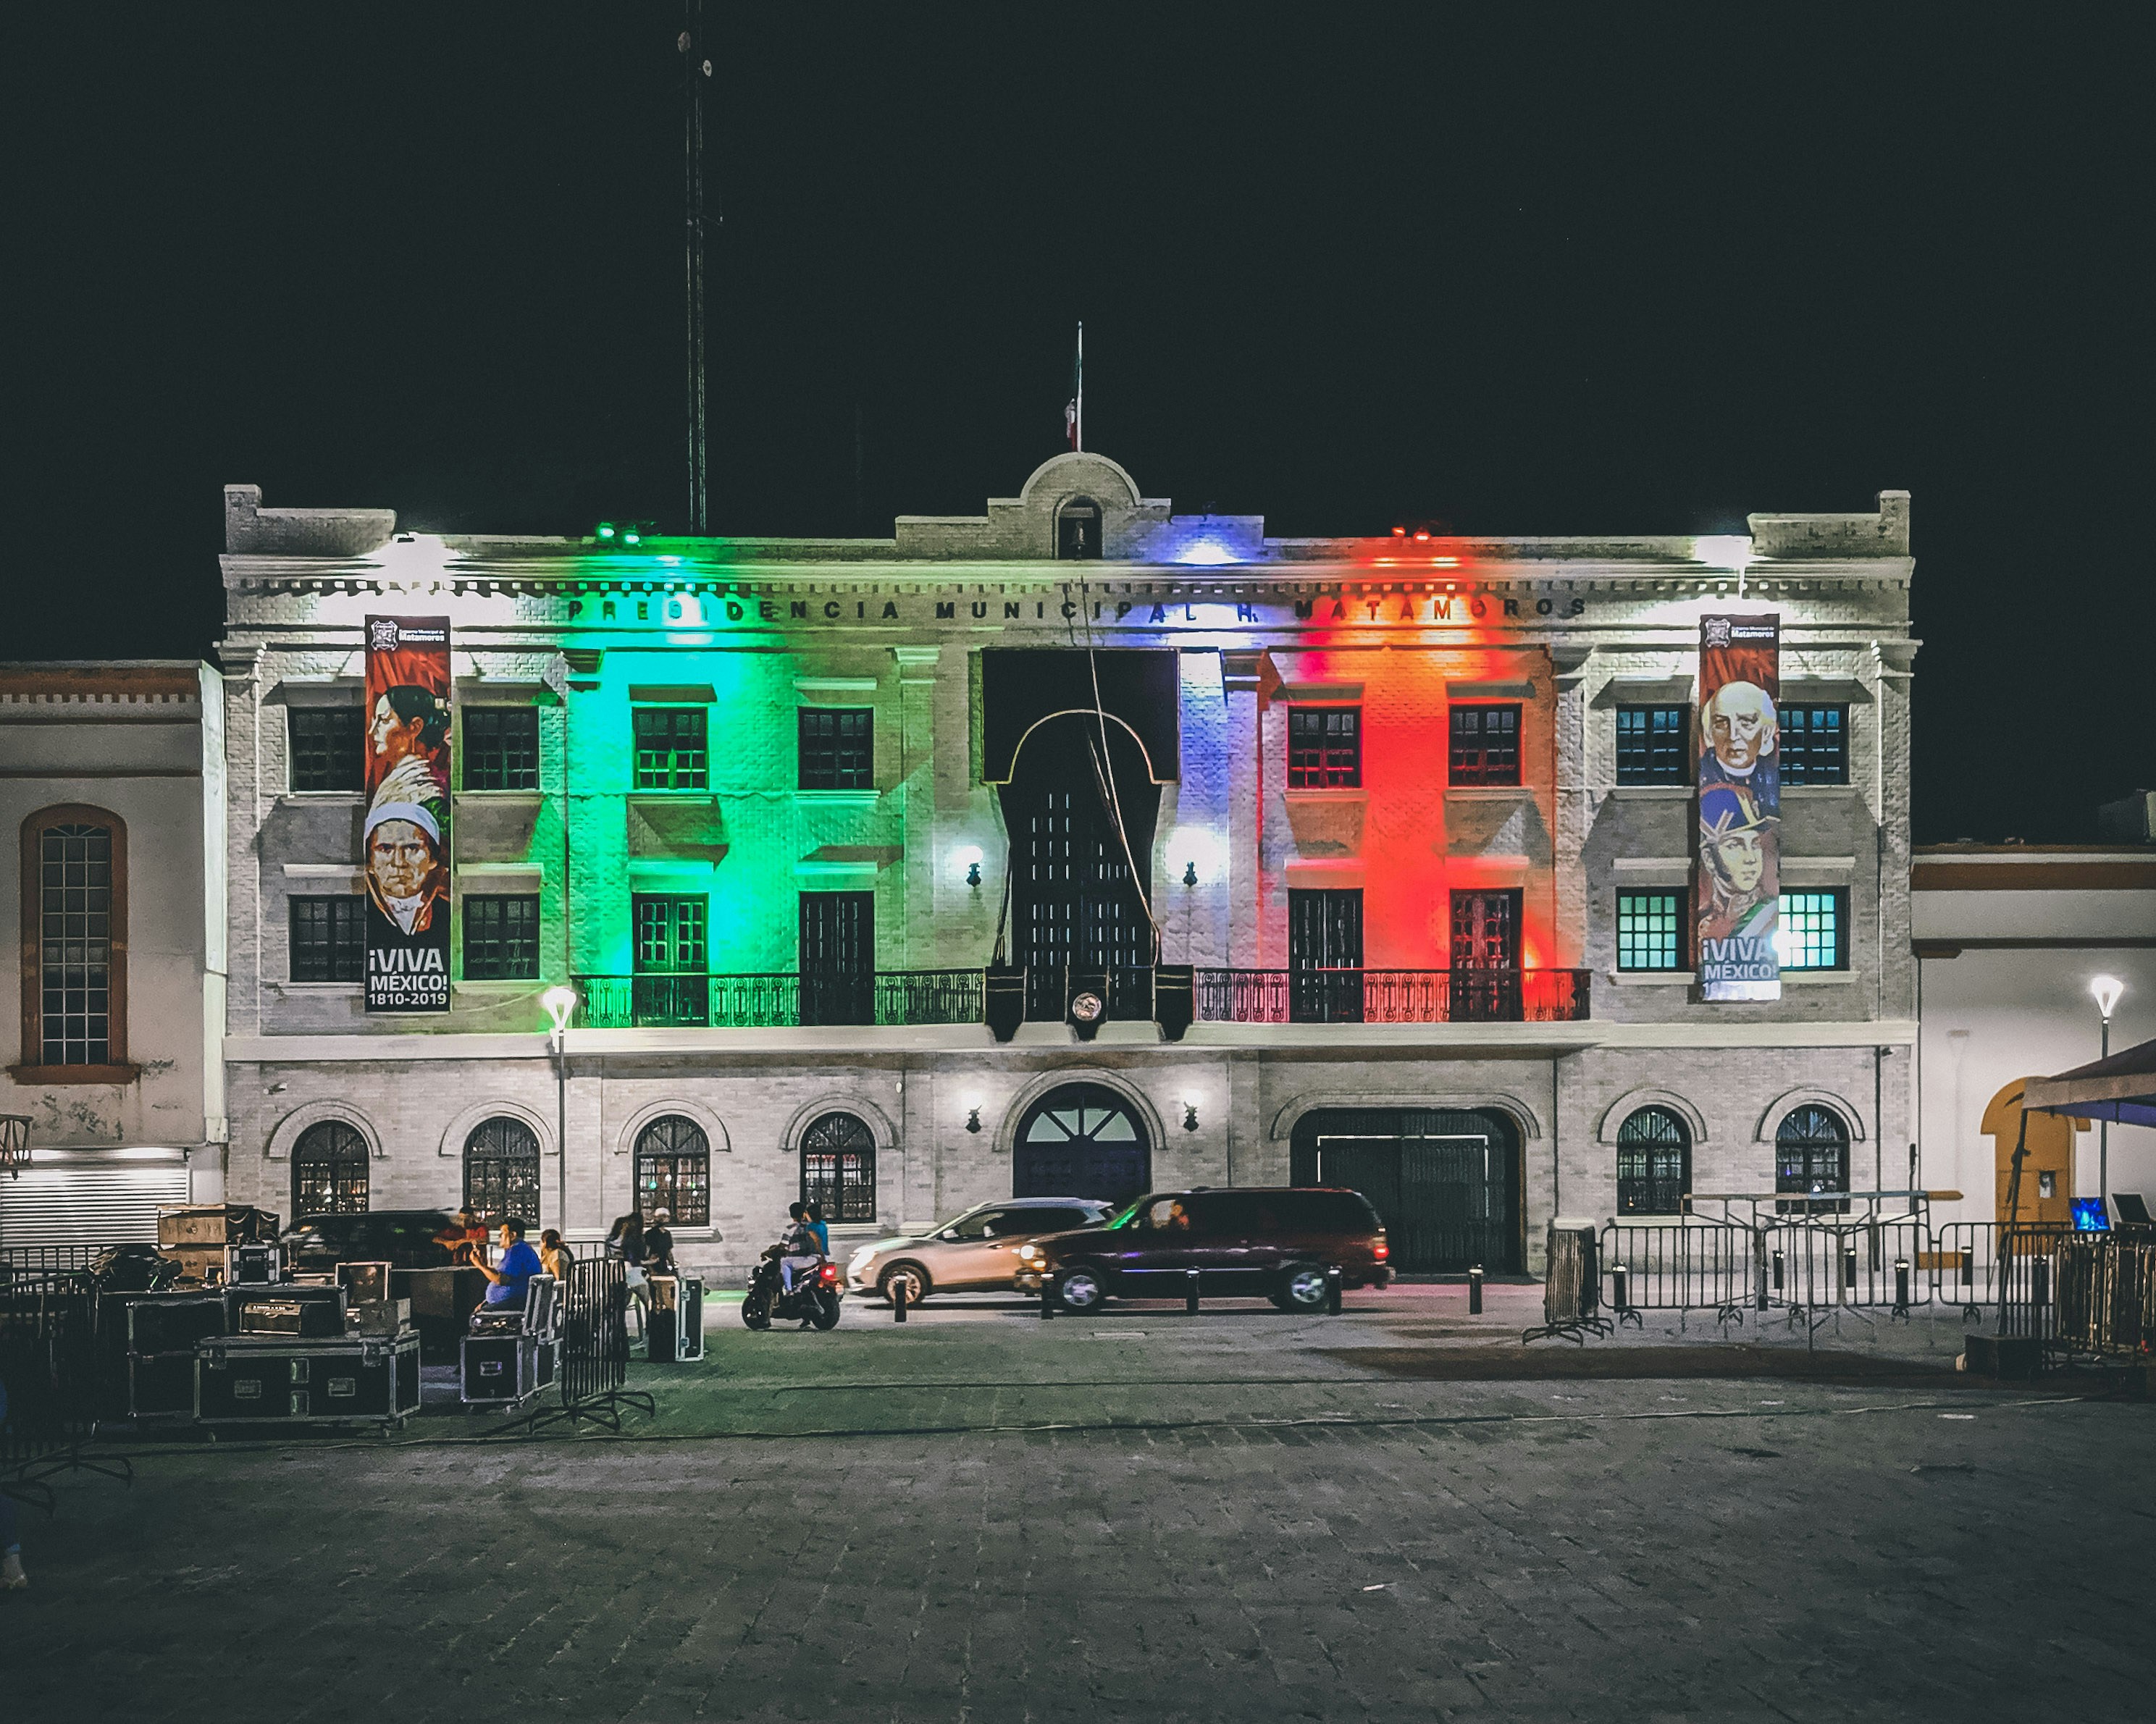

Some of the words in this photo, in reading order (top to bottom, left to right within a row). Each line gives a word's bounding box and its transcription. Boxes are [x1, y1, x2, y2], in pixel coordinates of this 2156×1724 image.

[935, 600, 1197, 622] MUNICIPAL
[1295, 600, 1585, 621] MATAMOROS
[369, 948, 444, 972] ¡VIVA
[371, 971, 448, 991] MÉXICO!
[369, 993, 447, 1005] 1810-2019
